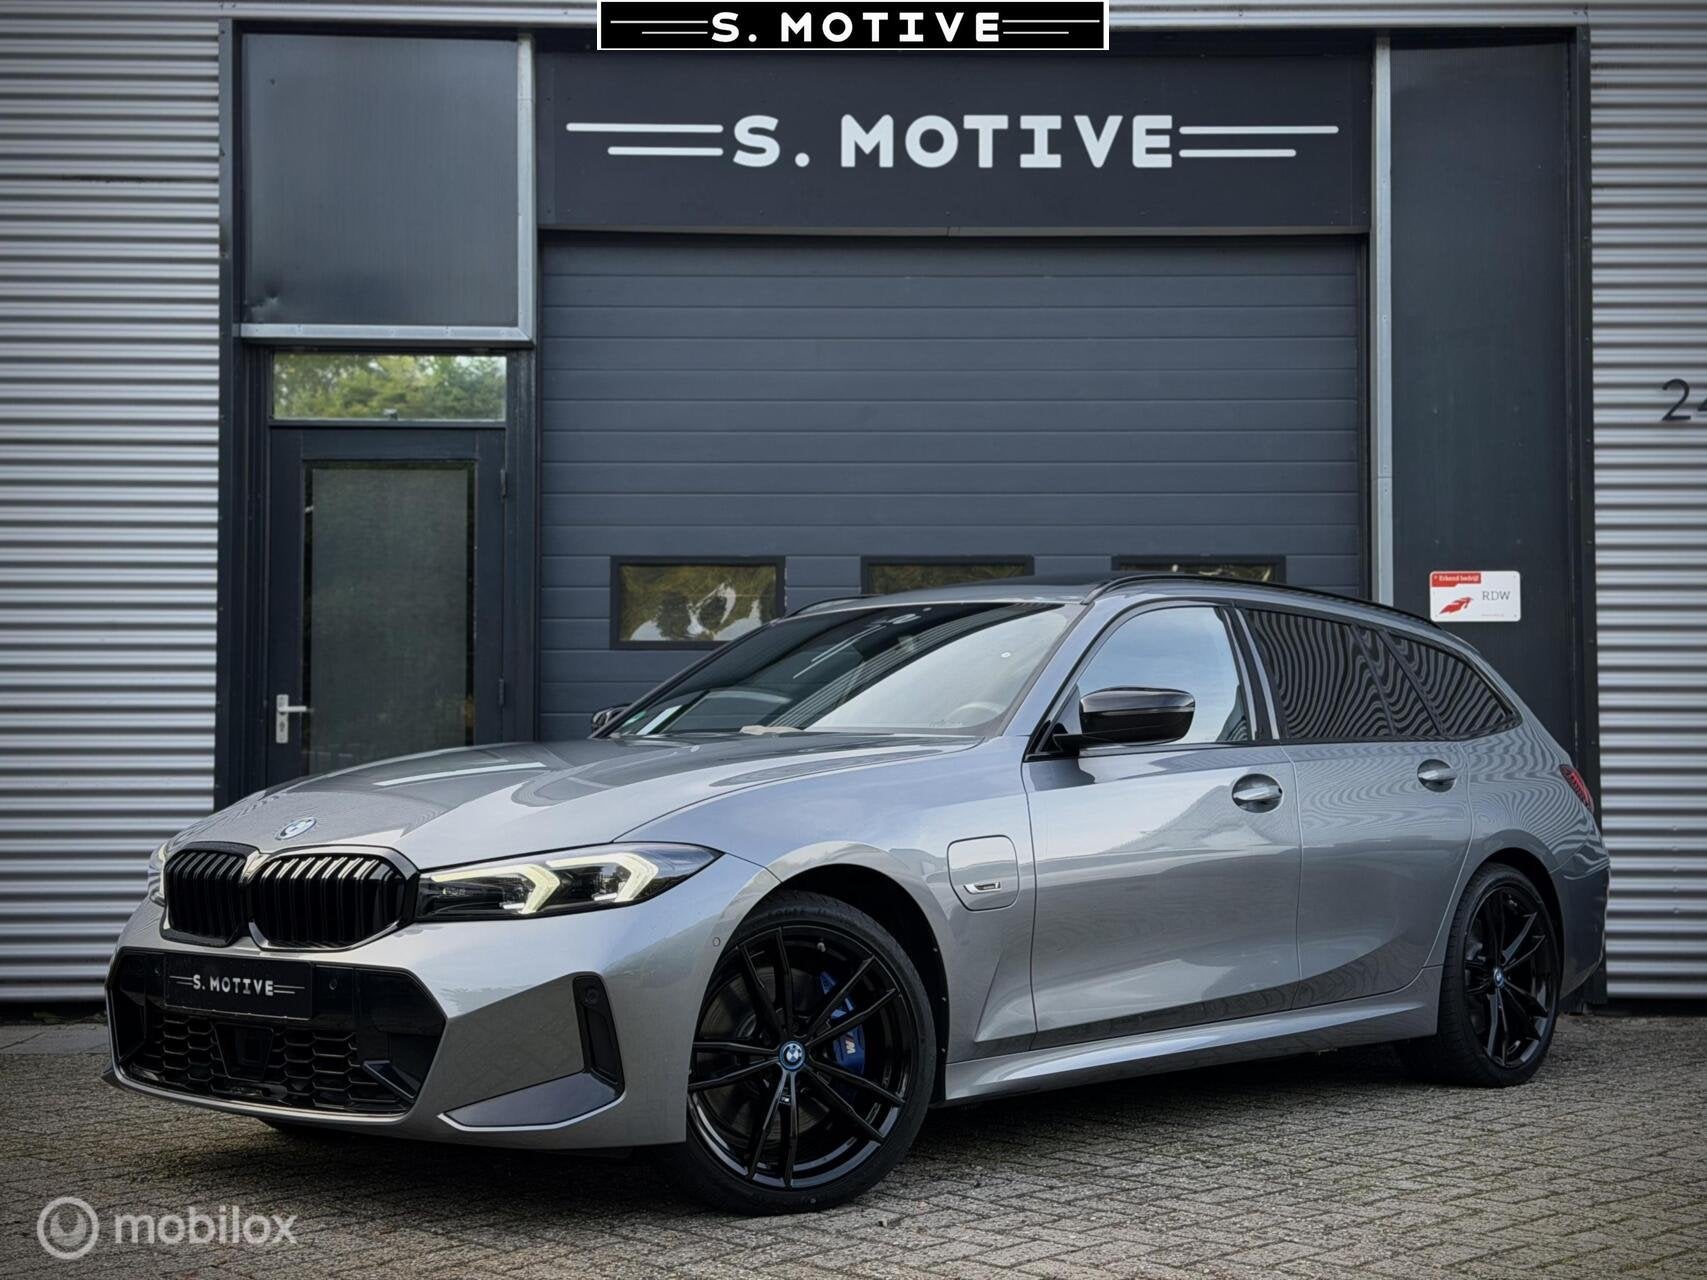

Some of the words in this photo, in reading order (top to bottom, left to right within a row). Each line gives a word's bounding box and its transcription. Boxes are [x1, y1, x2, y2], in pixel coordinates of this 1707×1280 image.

[733, 114, 810, 168] S.
[840, 114, 1173, 168] MOTIVE
[1482, 591, 1511, 601] RDW
[192, 974, 206, 990] S.
[209, 976, 274, 996] MOTIVE
